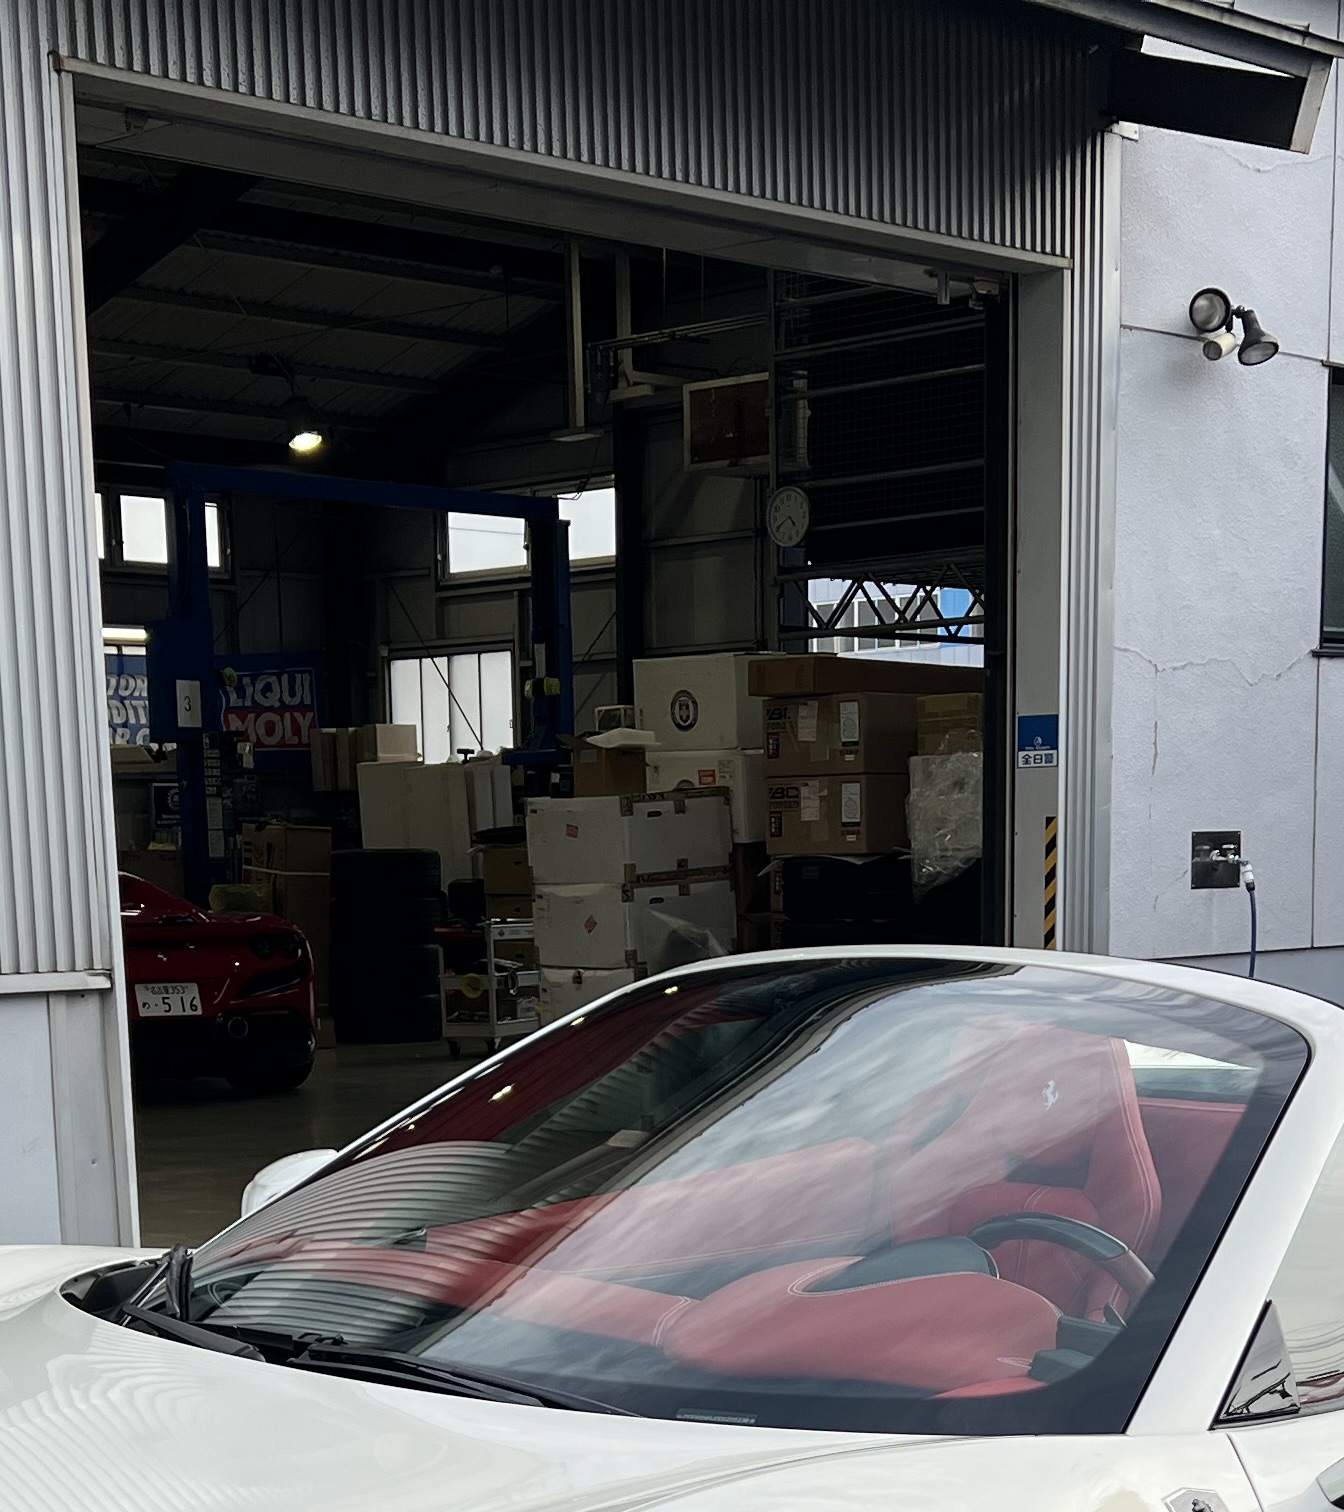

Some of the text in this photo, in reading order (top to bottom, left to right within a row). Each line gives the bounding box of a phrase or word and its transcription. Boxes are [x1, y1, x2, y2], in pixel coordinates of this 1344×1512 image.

[184, 696, 193, 712] 3
[225, 671, 312, 708] LIQUI
[108, 699, 149, 724] DIT
[227, 711, 314, 745] MOLY
